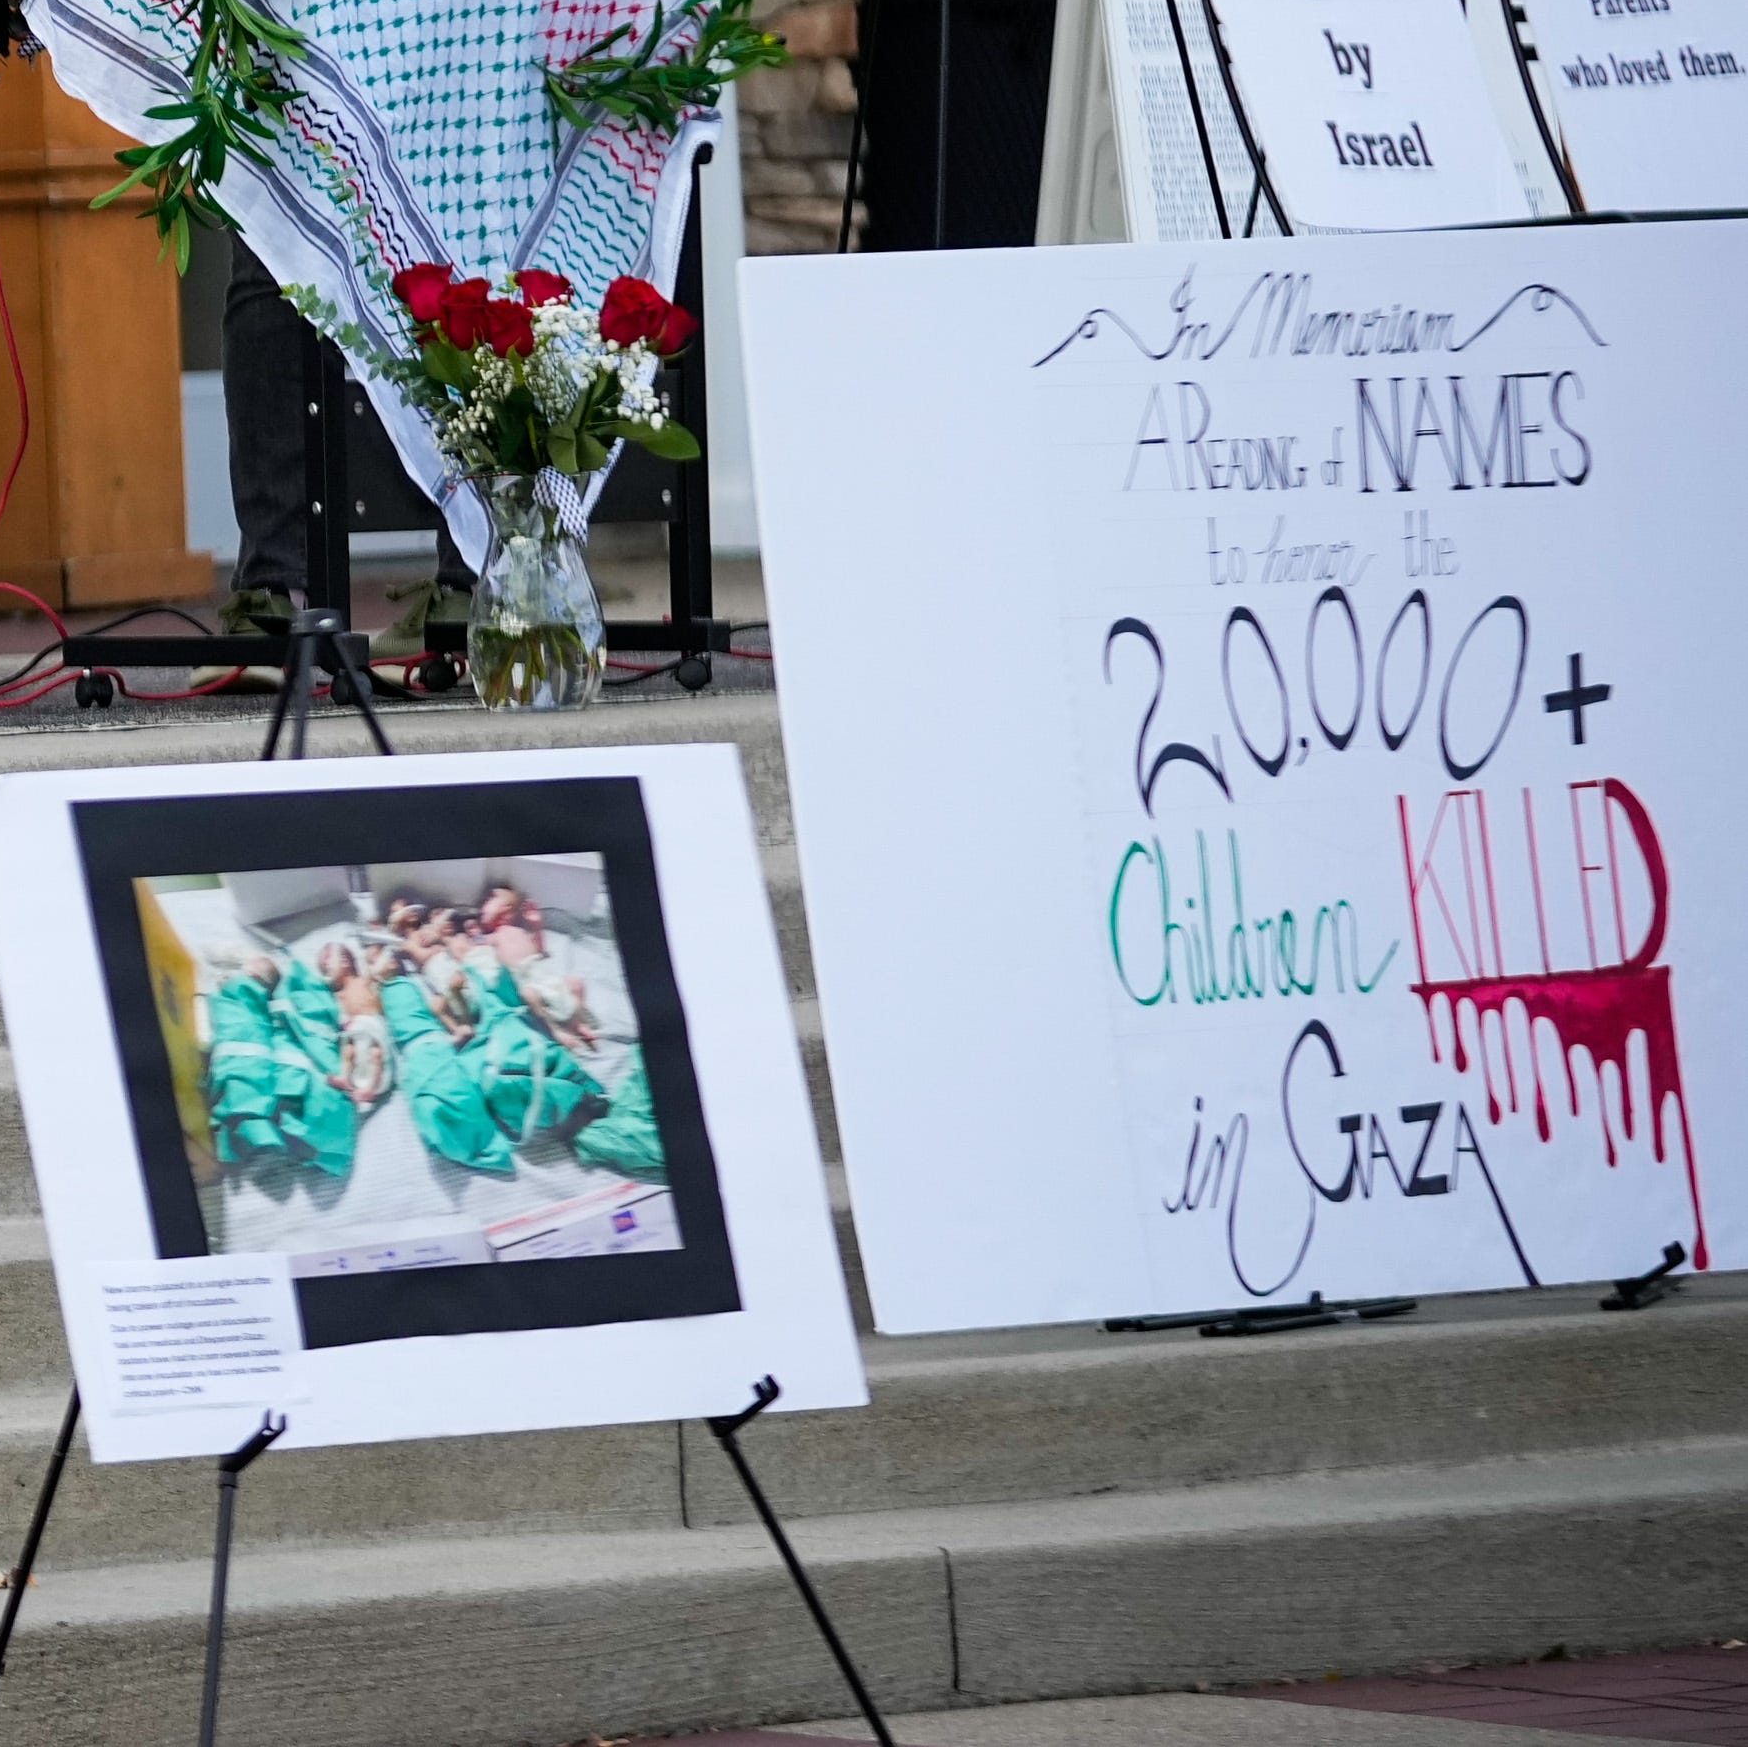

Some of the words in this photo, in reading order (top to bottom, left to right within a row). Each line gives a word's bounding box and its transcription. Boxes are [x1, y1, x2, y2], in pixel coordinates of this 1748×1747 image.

[1323, 29, 1372, 90] by
[1562, 54, 1609, 88] who
[1608, 51, 1672, 85] loved
[1325, 121, 1434, 167] Israel
[1354, 370, 1592, 493] NAMES
[1401, 509, 1460, 577] the
[1108, 829, 1401, 1007] Children
[1396, 777, 1673, 997] KILLED
